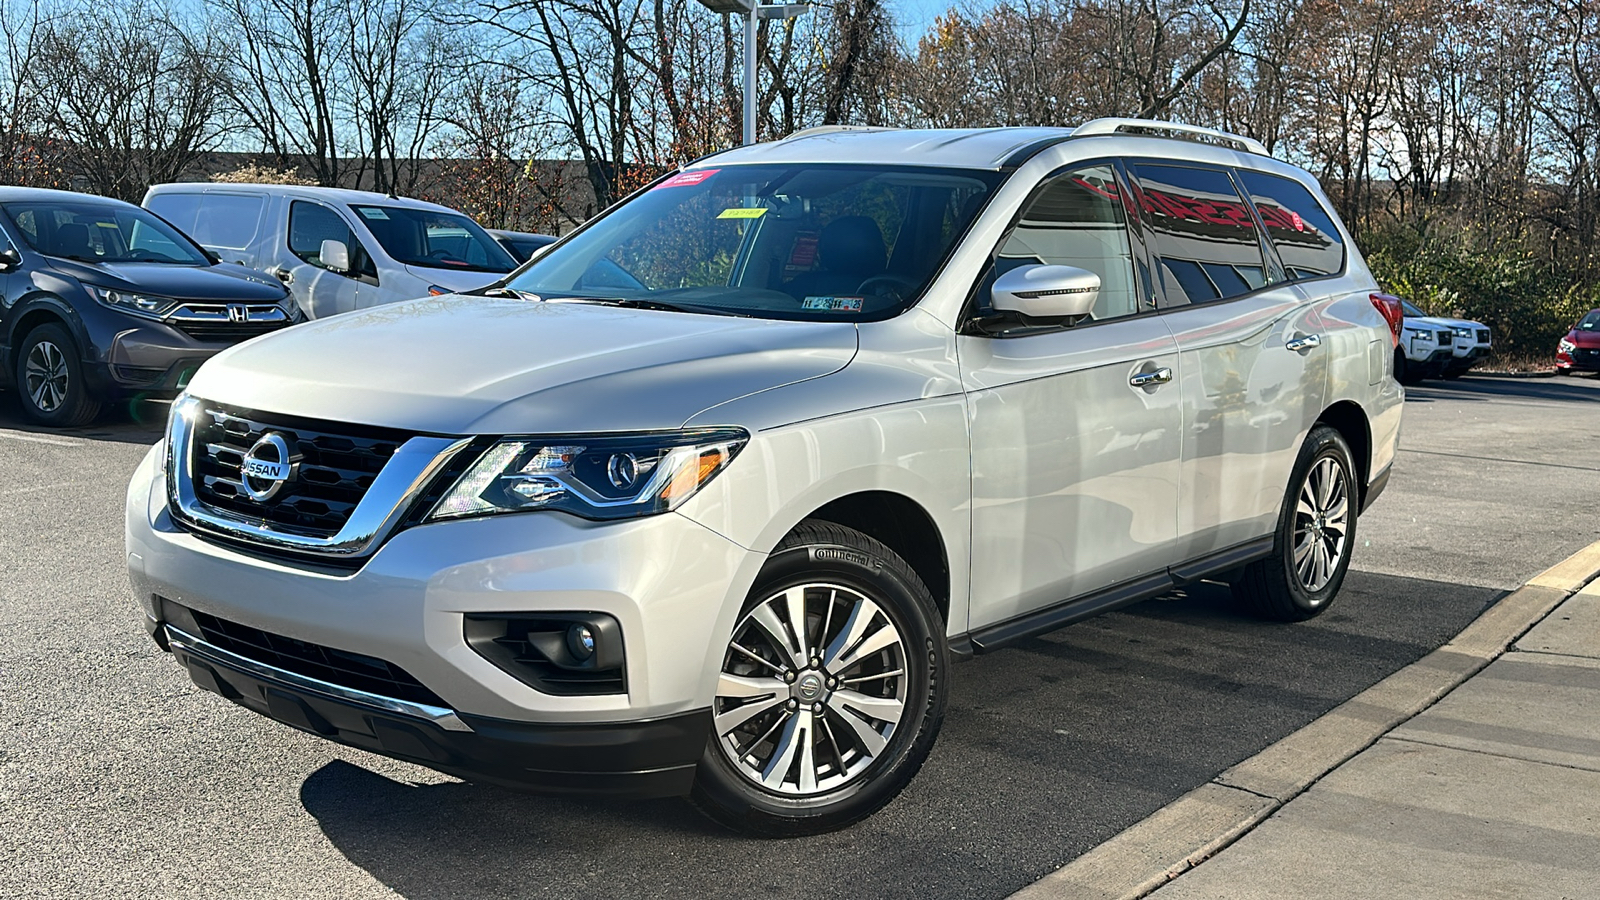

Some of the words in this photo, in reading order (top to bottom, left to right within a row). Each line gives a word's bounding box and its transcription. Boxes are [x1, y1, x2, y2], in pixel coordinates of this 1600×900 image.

[853, 299, 862, 309] 25
[243, 461, 281, 477] NISSAN
[814, 547, 869, 566] Continental
